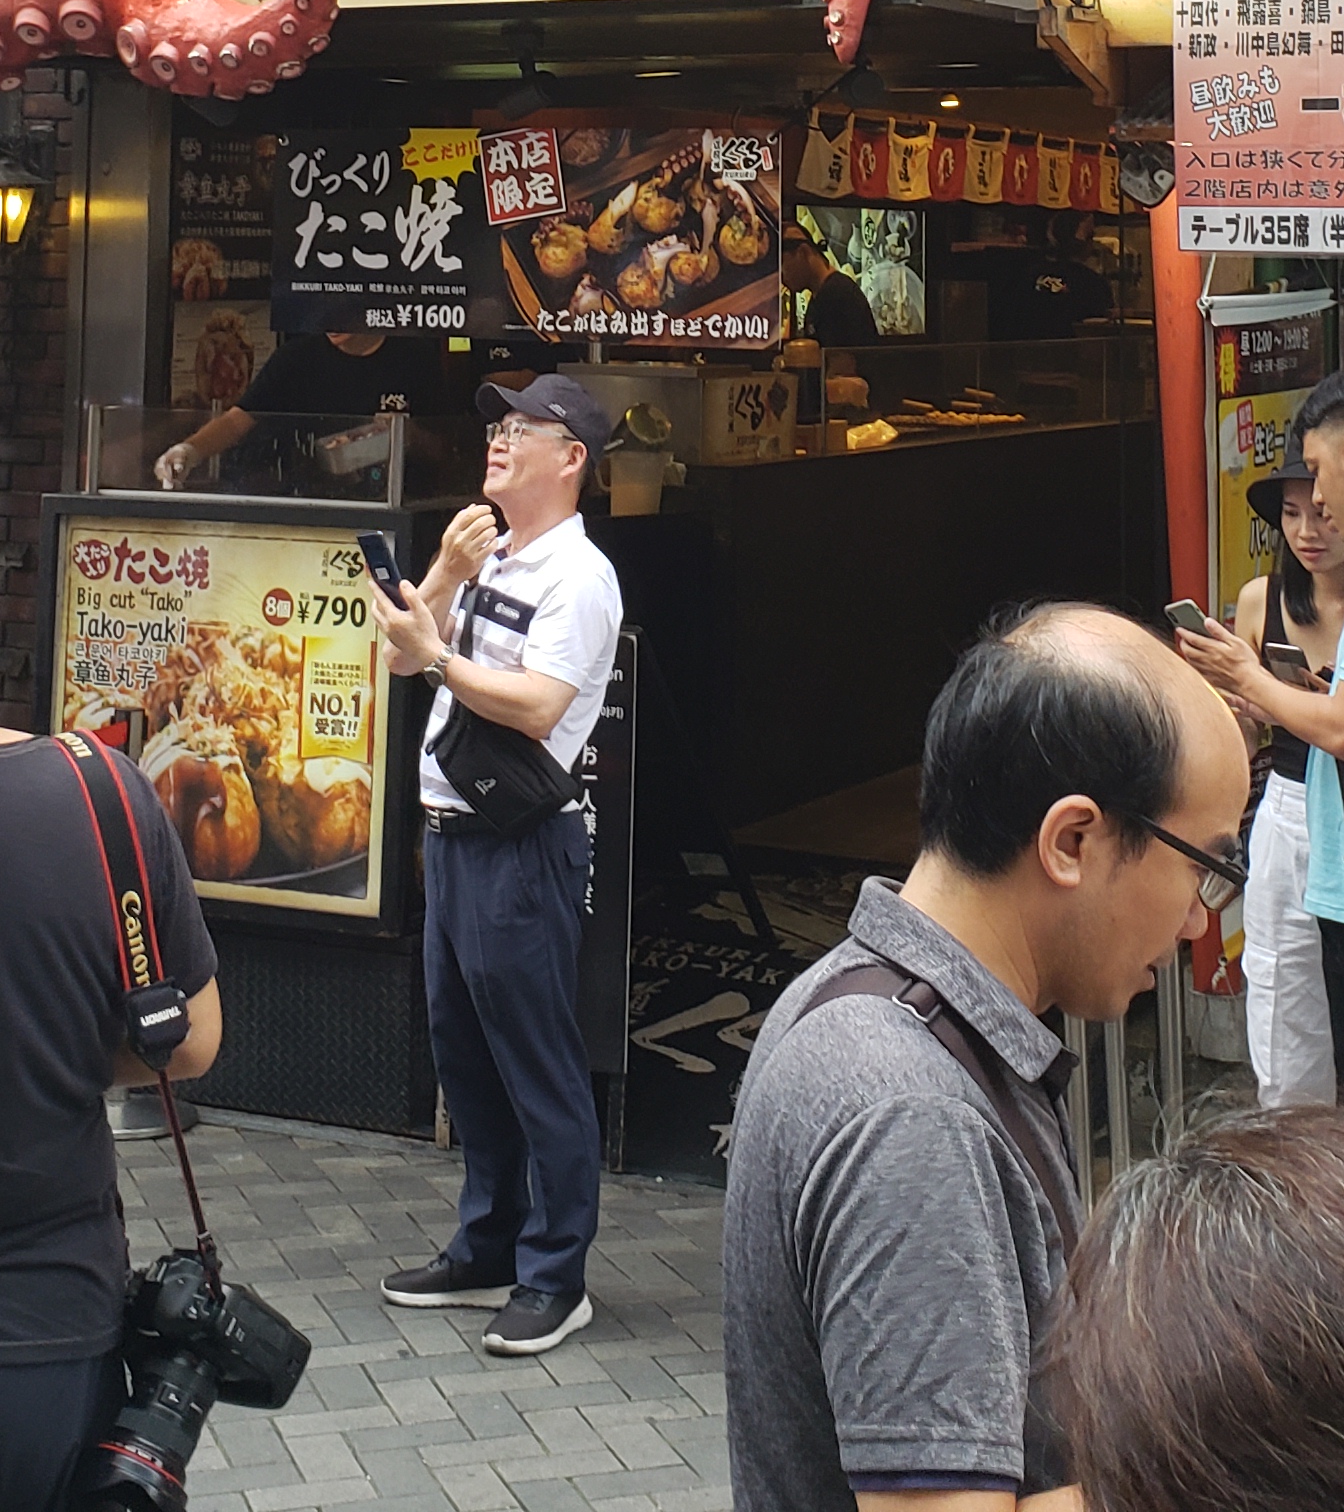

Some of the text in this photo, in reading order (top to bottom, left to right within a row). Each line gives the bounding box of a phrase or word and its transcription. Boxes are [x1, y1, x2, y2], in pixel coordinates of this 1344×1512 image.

[1188, 66, 1281, 111] 昼飲みも
[1206, 100, 1278, 142] 大歓迎
[287, 147, 390, 197] びっくり
[488, 132, 550, 174] 本店
[491, 173, 558, 216] 限定
[294, 178, 463, 272] たこ焼
[114, 537, 209, 589] たこ焼
[77, 587, 101, 610] Big
[110, 592, 135, 609] cut
[298, 595, 366, 627] ¥790
[77, 612, 186, 645] Tako-yaki
[310, 691, 361, 717] NO.1
